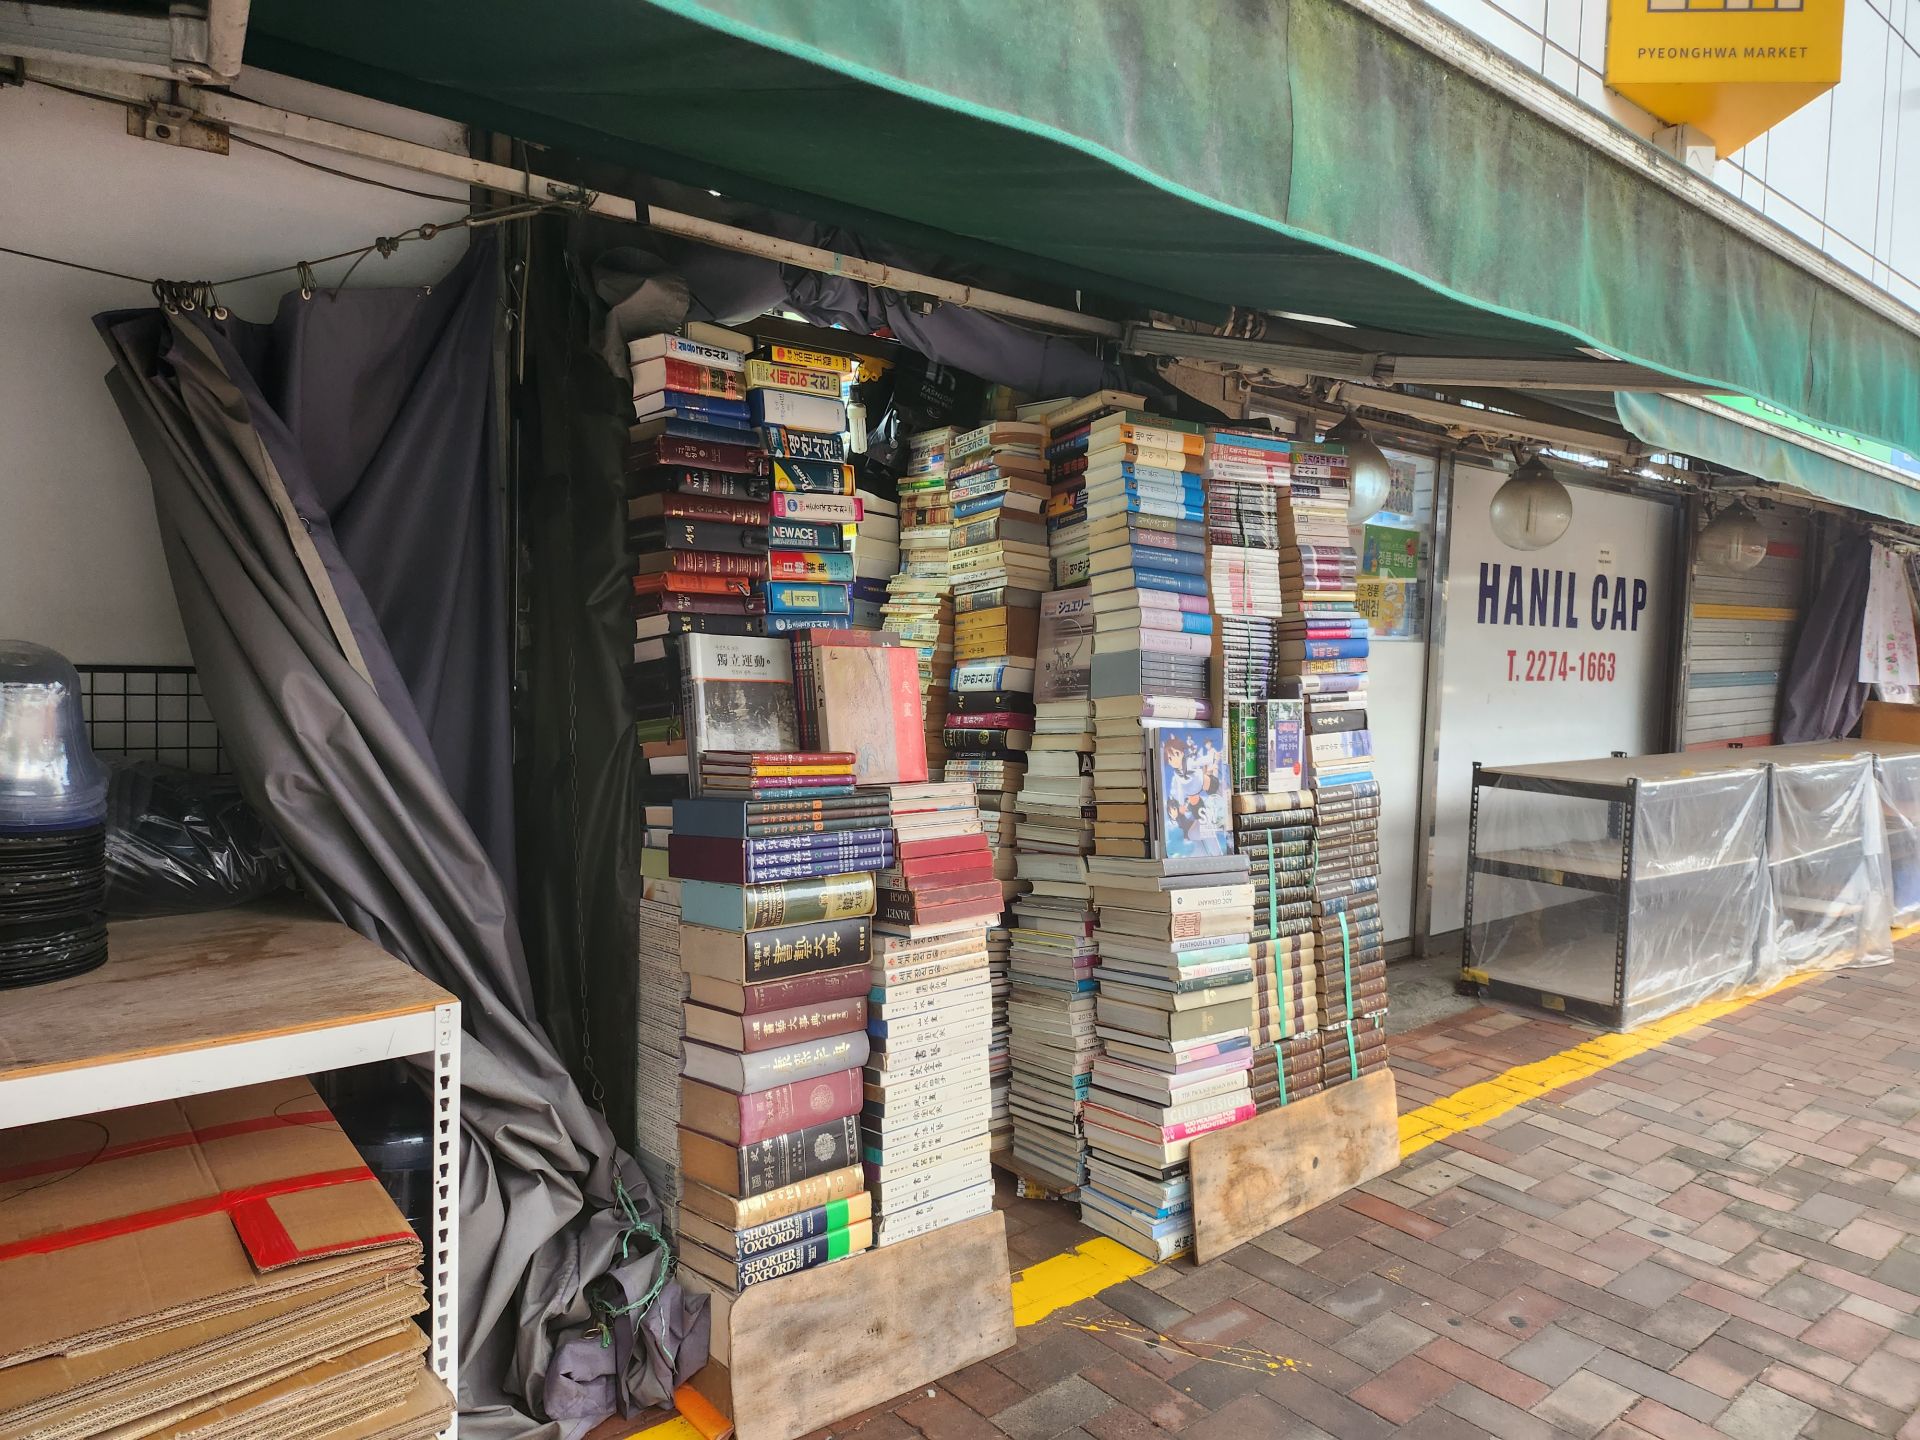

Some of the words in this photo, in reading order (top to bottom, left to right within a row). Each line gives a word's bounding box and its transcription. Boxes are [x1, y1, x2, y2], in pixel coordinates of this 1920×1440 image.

[1638, 47, 1737, 59] PYEONGHWA
[1743, 46, 1808, 58] MARKET
[769, 370, 830, 391] 스페인어사전
[789, 433, 834, 461] 영한사전
[1478, 562, 1578, 629] HANIL
[1591, 574, 1647, 631] CAP
[1507, 650, 1519, 682] T.
[1525, 650, 1616, 682] 2274-1663
[1179, 939, 1207, 949] PENTHOUSES
[1170, 1102, 1202, 1120] CLUB
[1203, 1095, 1243, 1112] DESIGN
[1184, 1119, 1196, 1128] 100
[1222, 1109, 1236, 1117] FOR
[1185, 1127, 1197, 1135] 100
[1197, 1115, 1236, 1132] ARCHITECTS
[744, 1217, 795, 1242] SHORTER
[744, 1231, 795, 1255] OXFORD
[745, 1249, 796, 1274] SHORTER
[745, 1262, 797, 1287] OXFORD
